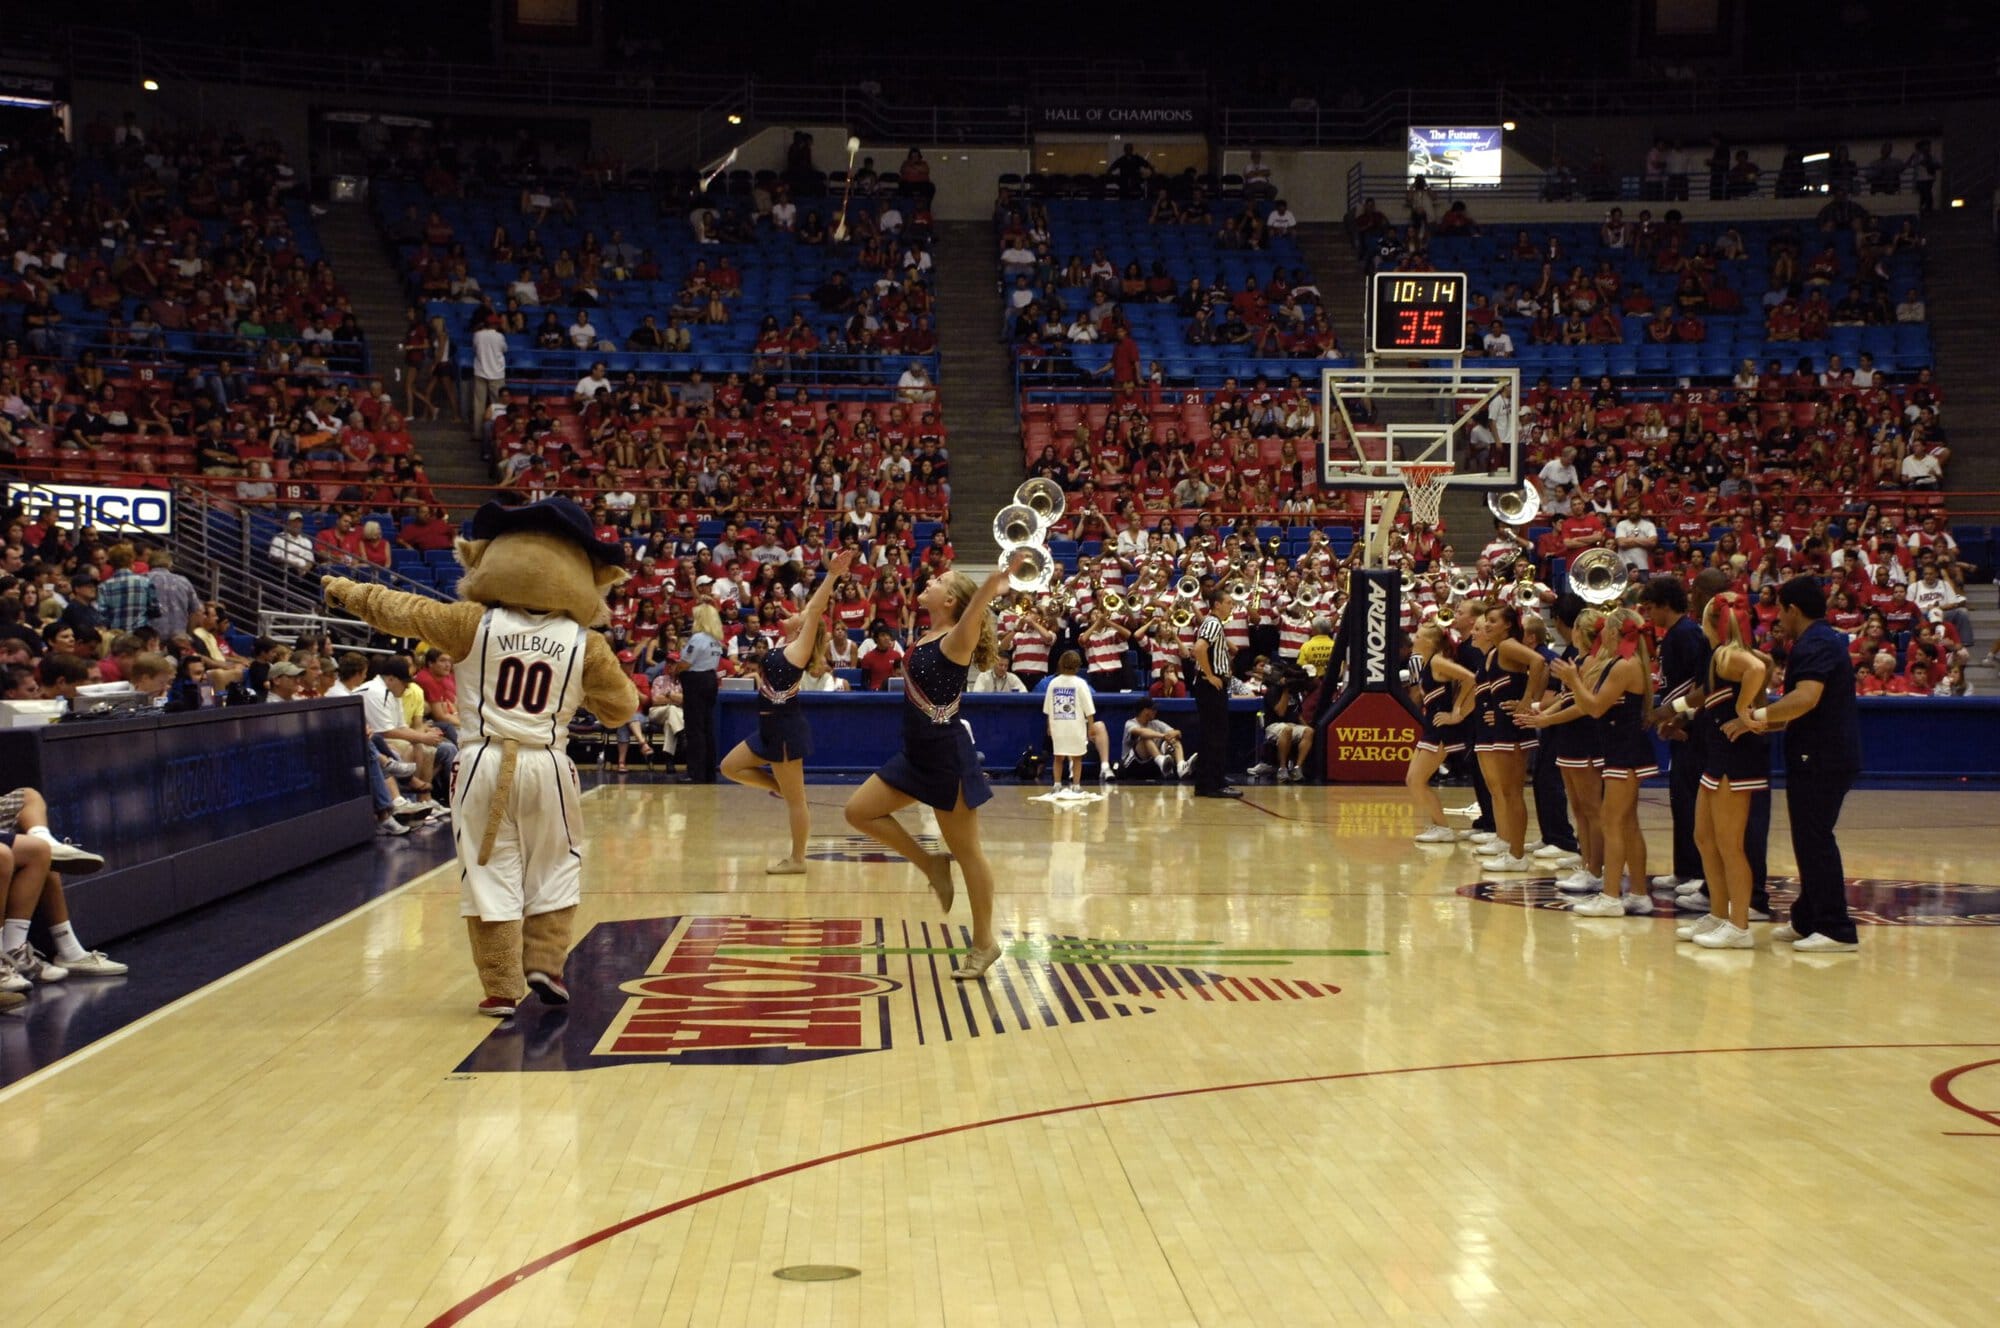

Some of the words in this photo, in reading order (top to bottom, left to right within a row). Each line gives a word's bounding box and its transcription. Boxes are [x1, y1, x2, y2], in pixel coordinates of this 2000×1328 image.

[1044, 108, 1080, 121] HALL
[1086, 108, 1103, 121] OF
[1108, 108, 1193, 122] CHAMPIONS
[1429, 129, 1446, 140] The
[1393, 281, 1455, 302] 10:14
[1395, 311, 1444, 344] 35
[140, 369, 153, 380] 19
[1186, 394, 1200, 404] 21
[1687, 392, 1703, 404] 22
[286, 485, 300, 498] 19
[12, 491, 167, 527] GEICO
[1366, 578, 1387, 683] ARIZONA
[497, 634, 565, 662] WILBUR
[495, 656, 553, 715] 00
[1336, 727, 1415, 743] WELLS
[1338, 746, 1414, 762] FARGO
[600, 916, 890, 1055] ARIZONA
